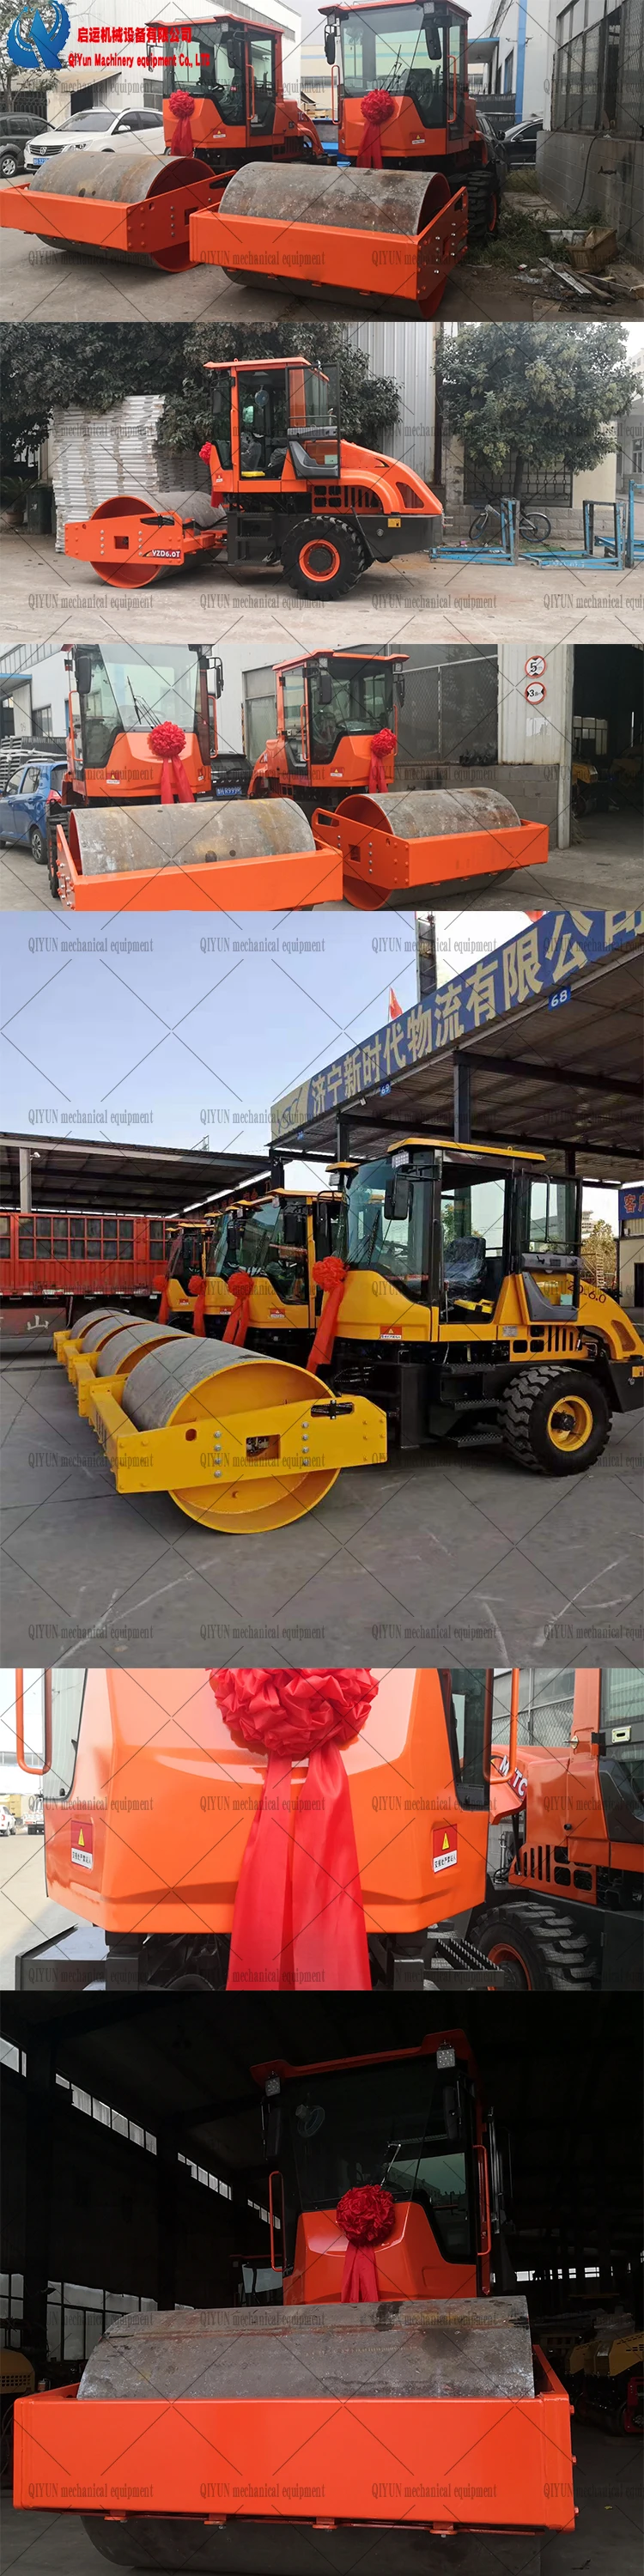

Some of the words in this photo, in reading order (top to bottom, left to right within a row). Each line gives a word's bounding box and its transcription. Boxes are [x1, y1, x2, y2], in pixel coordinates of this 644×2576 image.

[151, 550, 181, 558] YZD6.0T
[550, 989, 568, 1008] 68
[380, 1083, 391, 1095] 69
